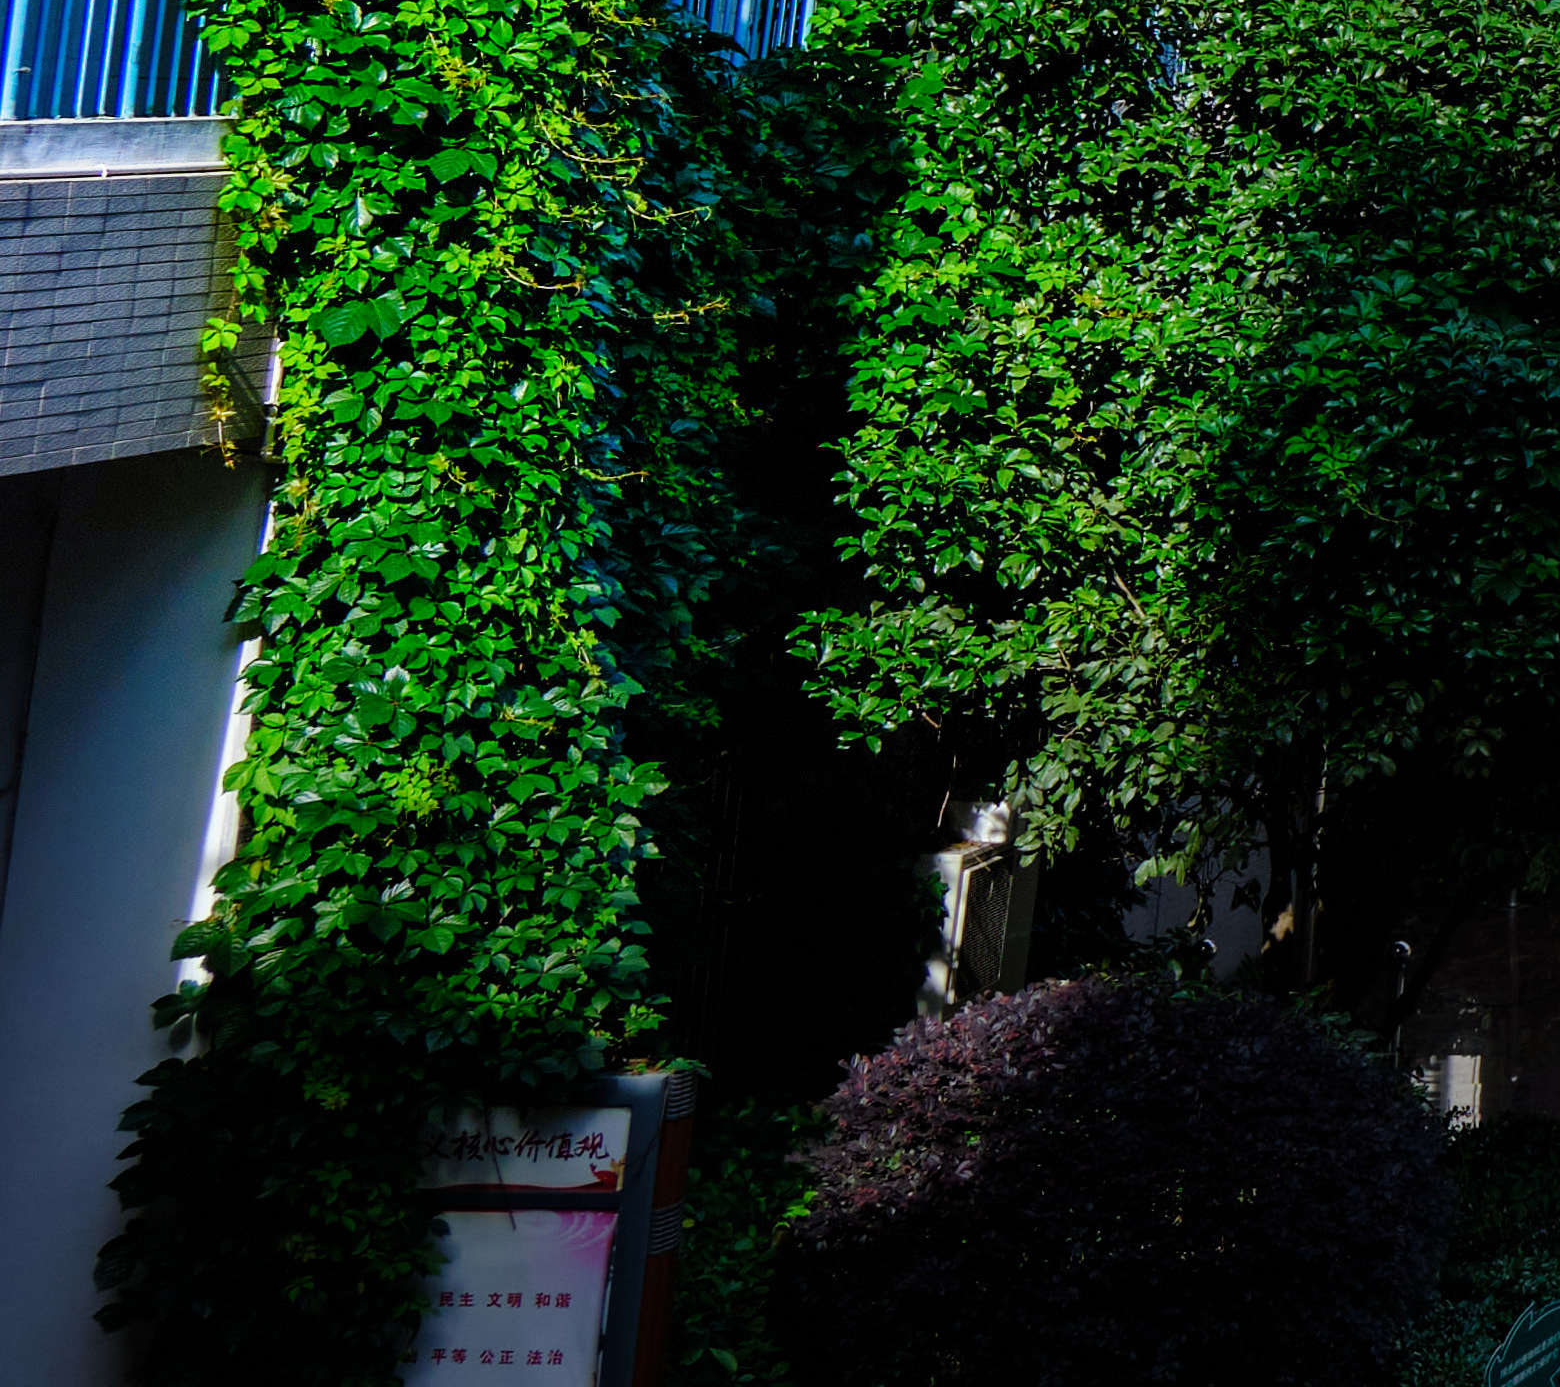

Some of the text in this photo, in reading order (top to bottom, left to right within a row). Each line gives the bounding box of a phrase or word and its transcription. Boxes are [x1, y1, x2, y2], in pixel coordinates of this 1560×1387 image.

[439, 1291, 572, 1309] 民主 文明 和谐
[431, 1348, 468, 1365] 平等
[479, 1349, 515, 1365] 公正
[526, 1349, 564, 1366] 法治
